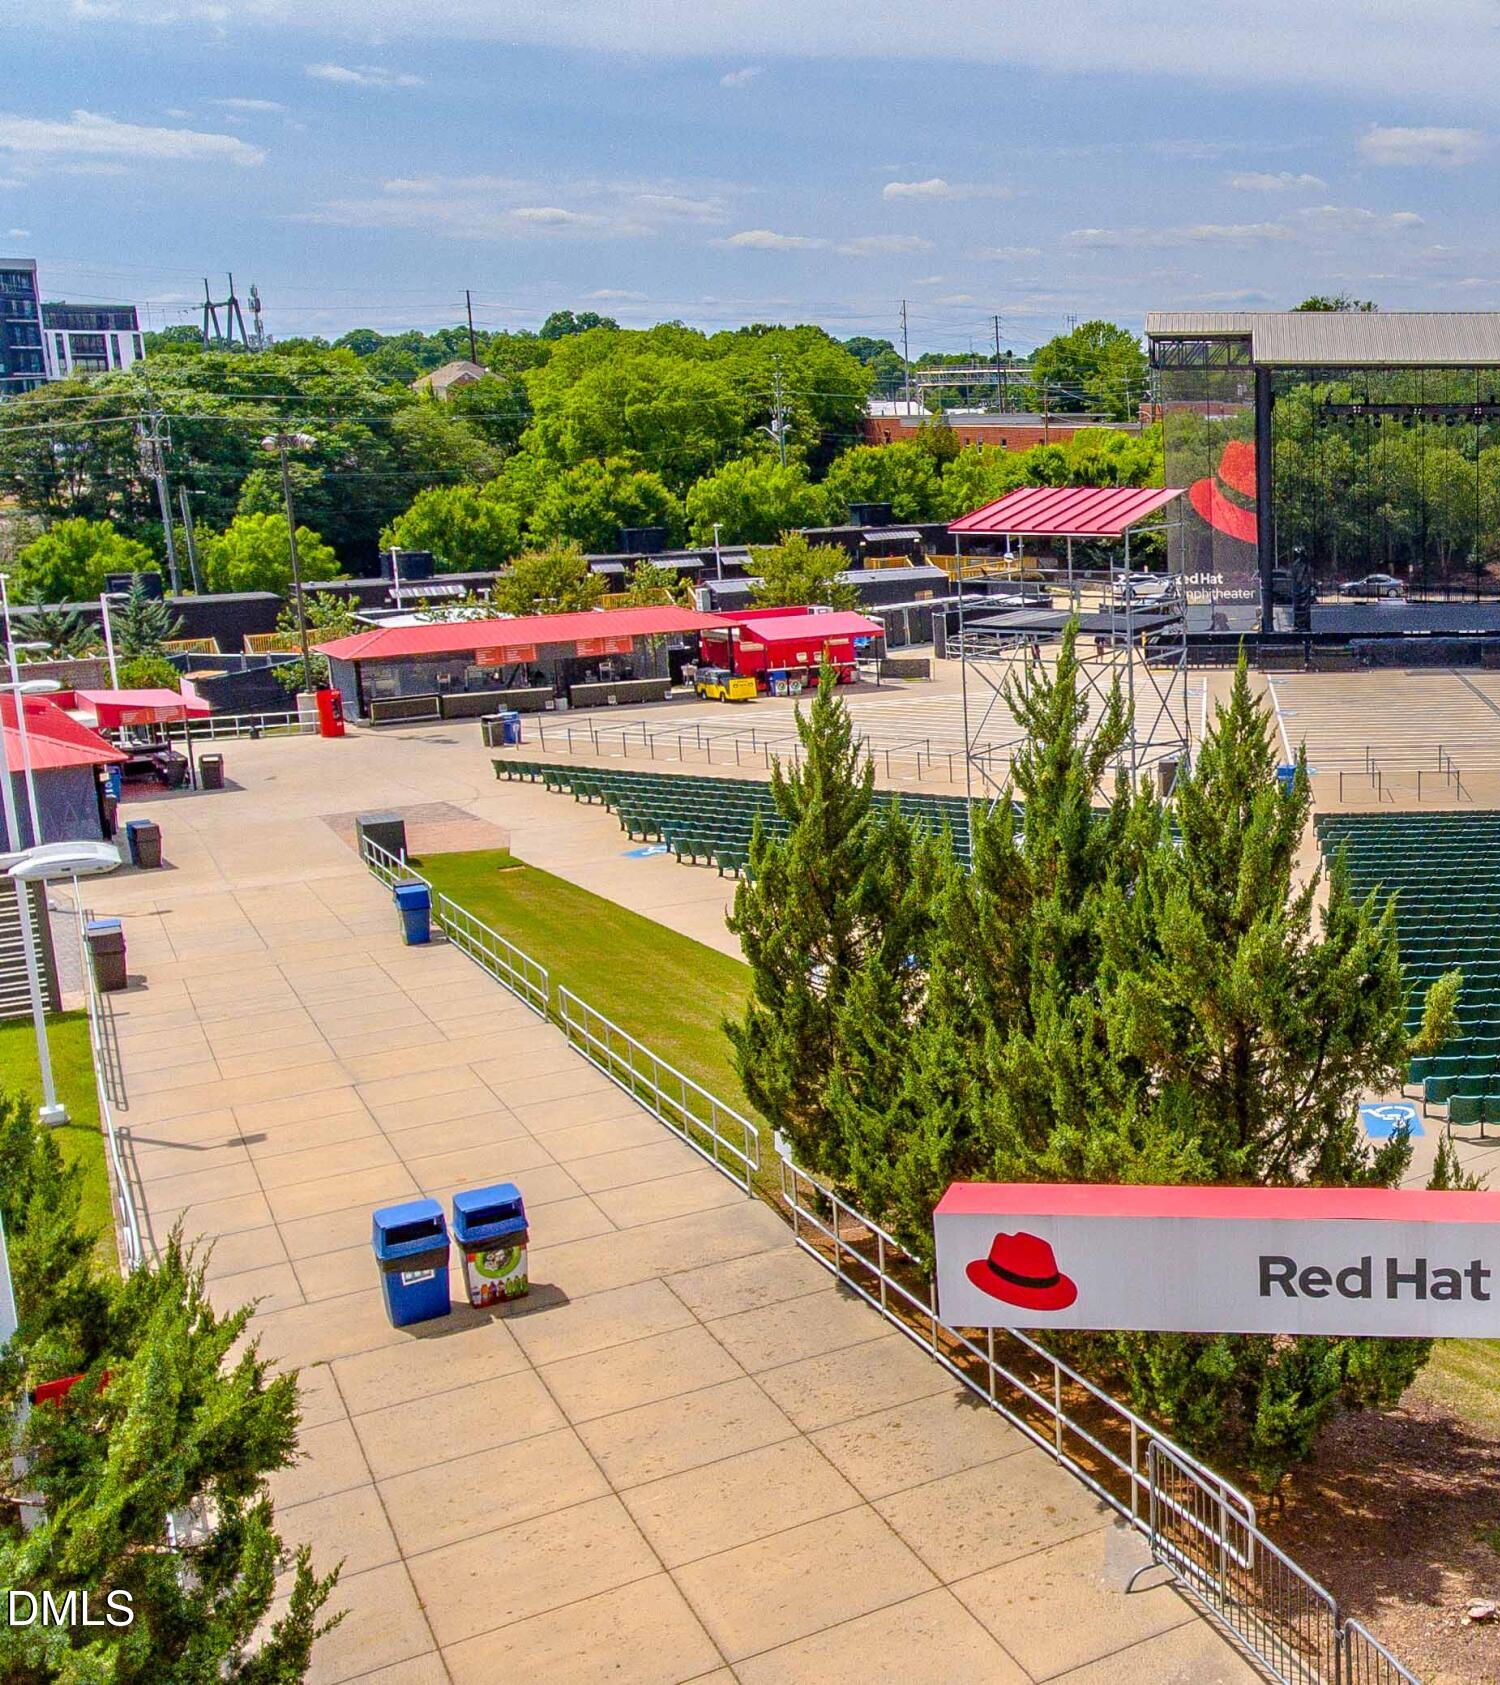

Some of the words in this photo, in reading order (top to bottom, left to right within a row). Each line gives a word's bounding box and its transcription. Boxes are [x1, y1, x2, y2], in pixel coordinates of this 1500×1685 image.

[1201, 573, 1223, 584] Hat
[1257, 1254, 1373, 1300] Red
[1386, 1256, 1491, 1302] Hat
